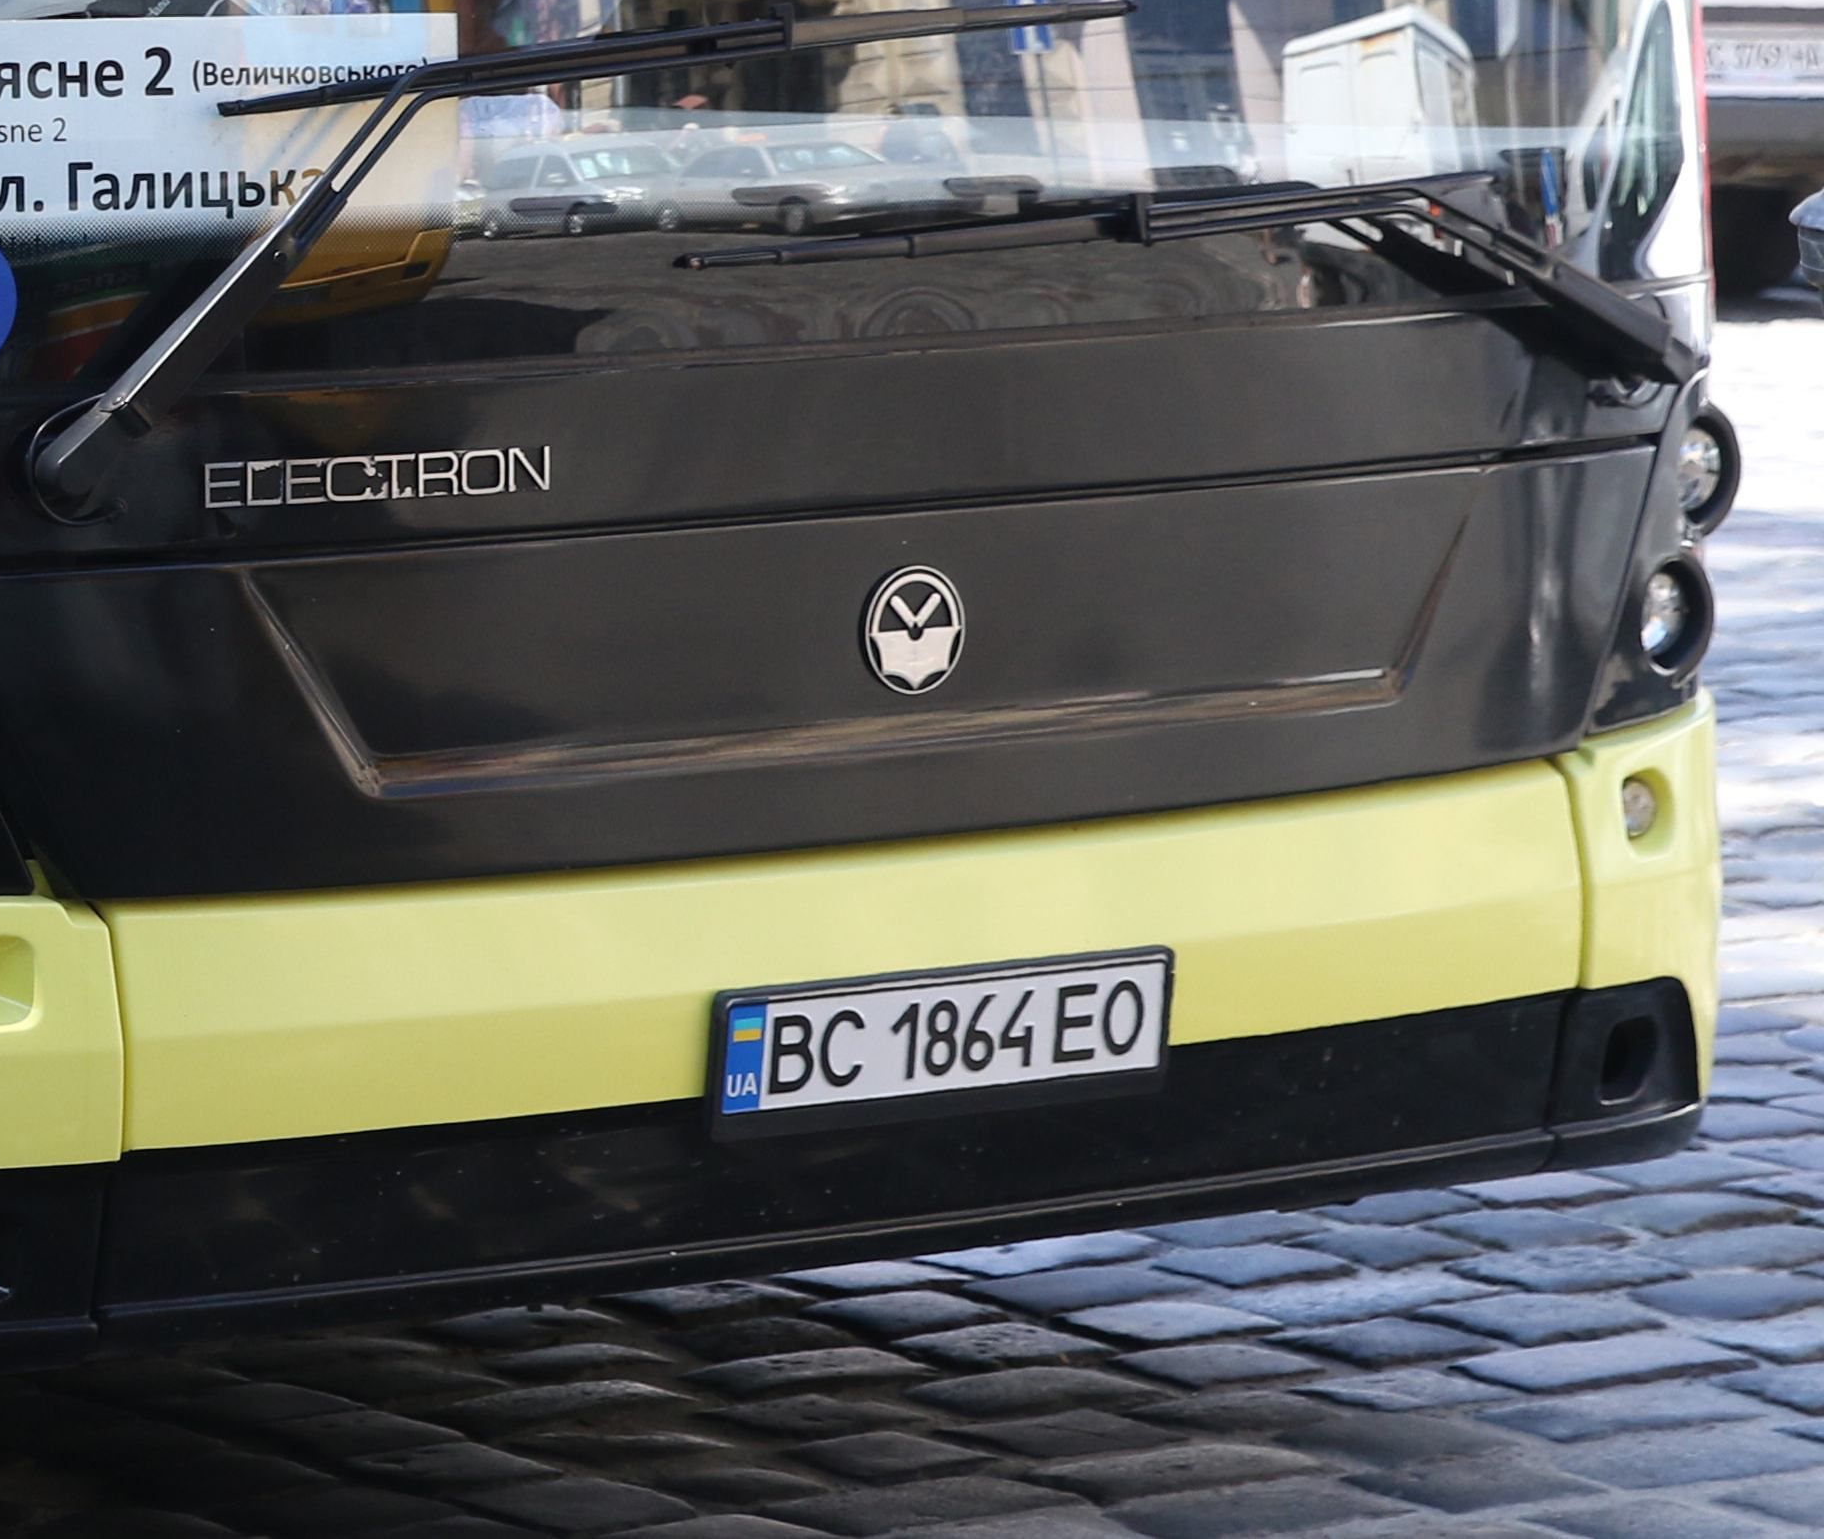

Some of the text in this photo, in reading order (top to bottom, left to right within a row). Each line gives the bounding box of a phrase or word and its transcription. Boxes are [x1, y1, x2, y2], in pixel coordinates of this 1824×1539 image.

[145, 47, 174, 97] 2
[53, 117, 67, 142] 2
[204, 445, 551, 509] ELECTRON
[768, 979, 1145, 1095] BC 1864 EO
[726, 1072, 758, 1099] UA
